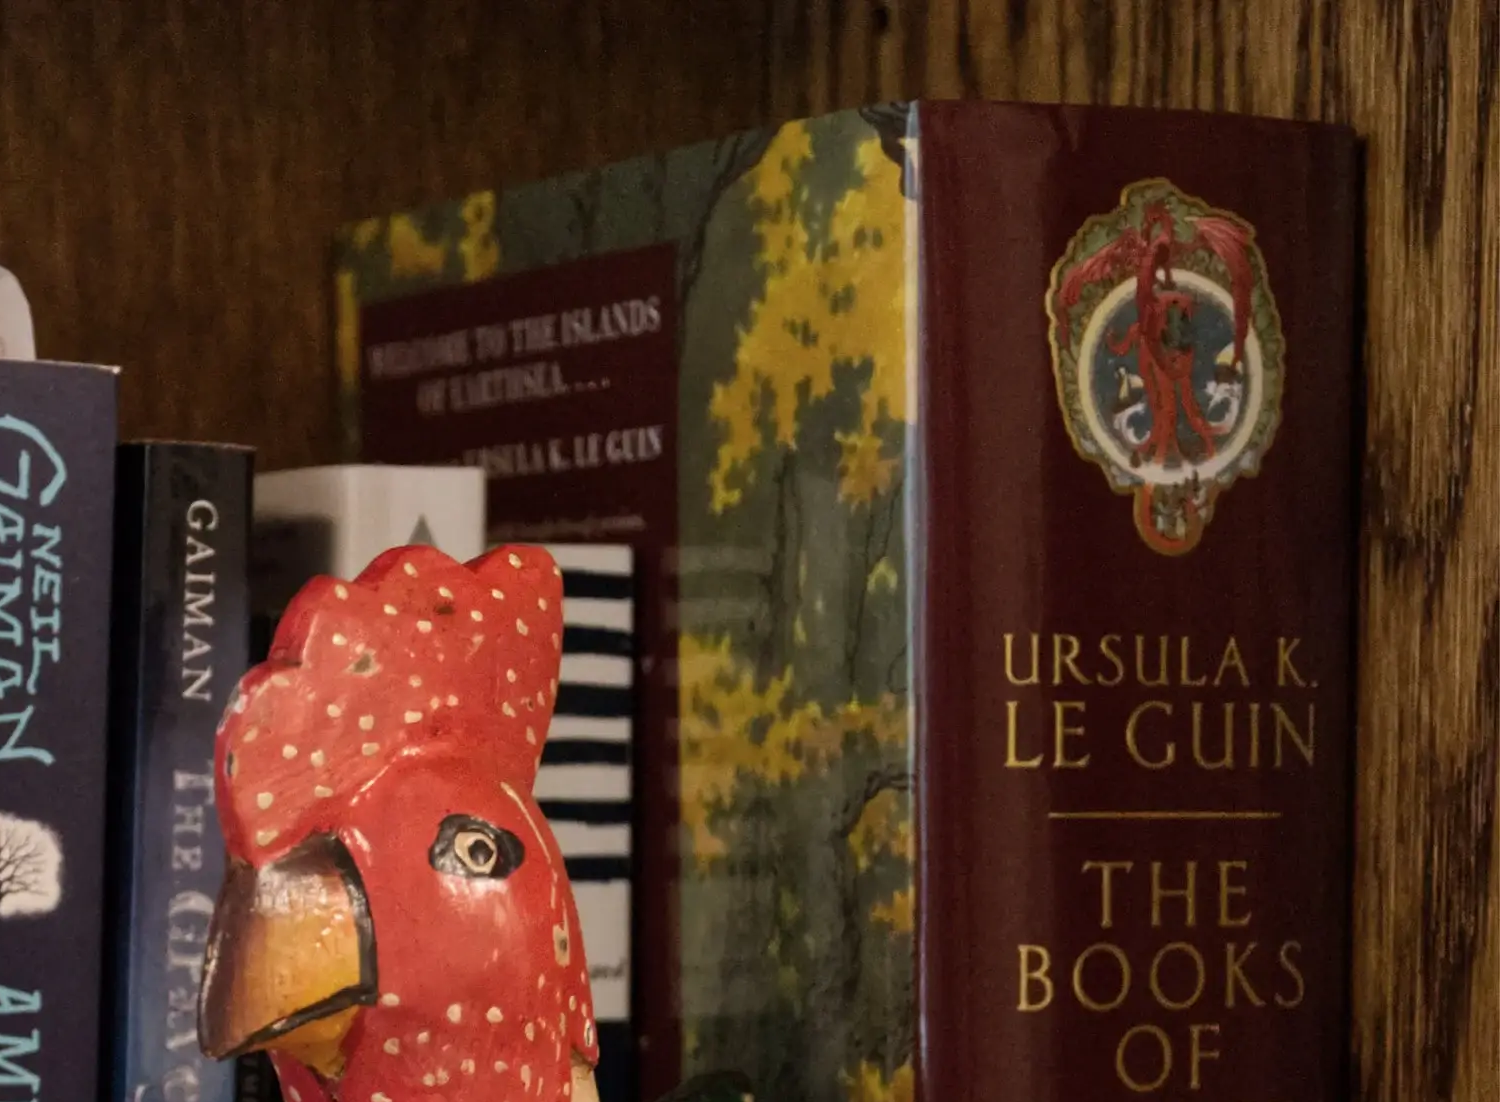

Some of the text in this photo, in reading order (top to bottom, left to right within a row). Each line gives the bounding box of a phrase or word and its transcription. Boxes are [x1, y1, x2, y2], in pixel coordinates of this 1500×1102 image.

[27, 524, 63, 694] NEIL
[181, 499, 219, 701] GAIMAN
[1003, 633, 1319, 688] URSULA K.
[1003, 701, 1316, 770] LE GUIN
[1081, 861, 1252, 928] THE
[1016, 941, 1306, 1013] BOOKS
[1116, 1023, 1220, 1093] OF
